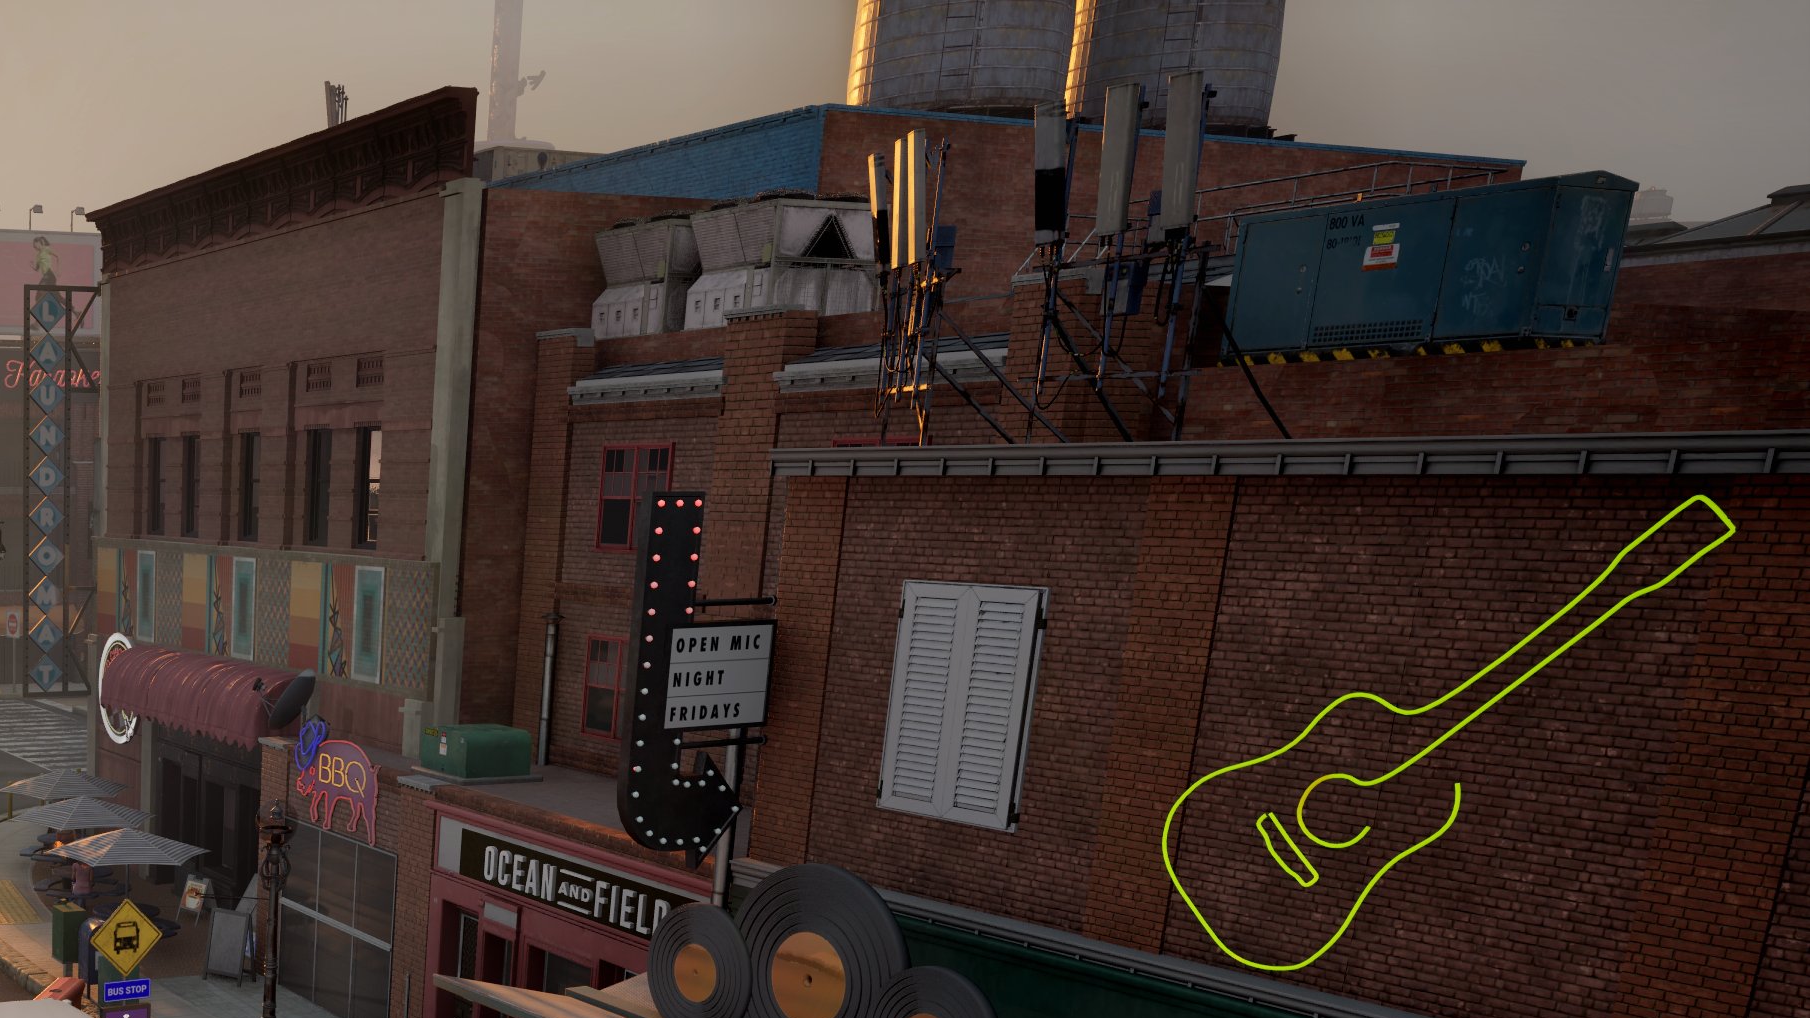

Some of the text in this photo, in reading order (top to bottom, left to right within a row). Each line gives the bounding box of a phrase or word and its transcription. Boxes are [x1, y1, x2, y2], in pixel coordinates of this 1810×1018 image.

[1329, 214, 1365, 230] 800 VA
[37, 300, 58, 684] LAUNDROMAT
[676, 634, 761, 653] OPEN MIC
[672, 669, 725, 688] NIGHT
[669, 702, 741, 722] FRIDAYS
[318, 753, 367, 799] BBQ
[483, 845, 558, 902] OCEAN
[557, 881, 594, 903] AND
[107, 984, 147, 997] BUS STOP
